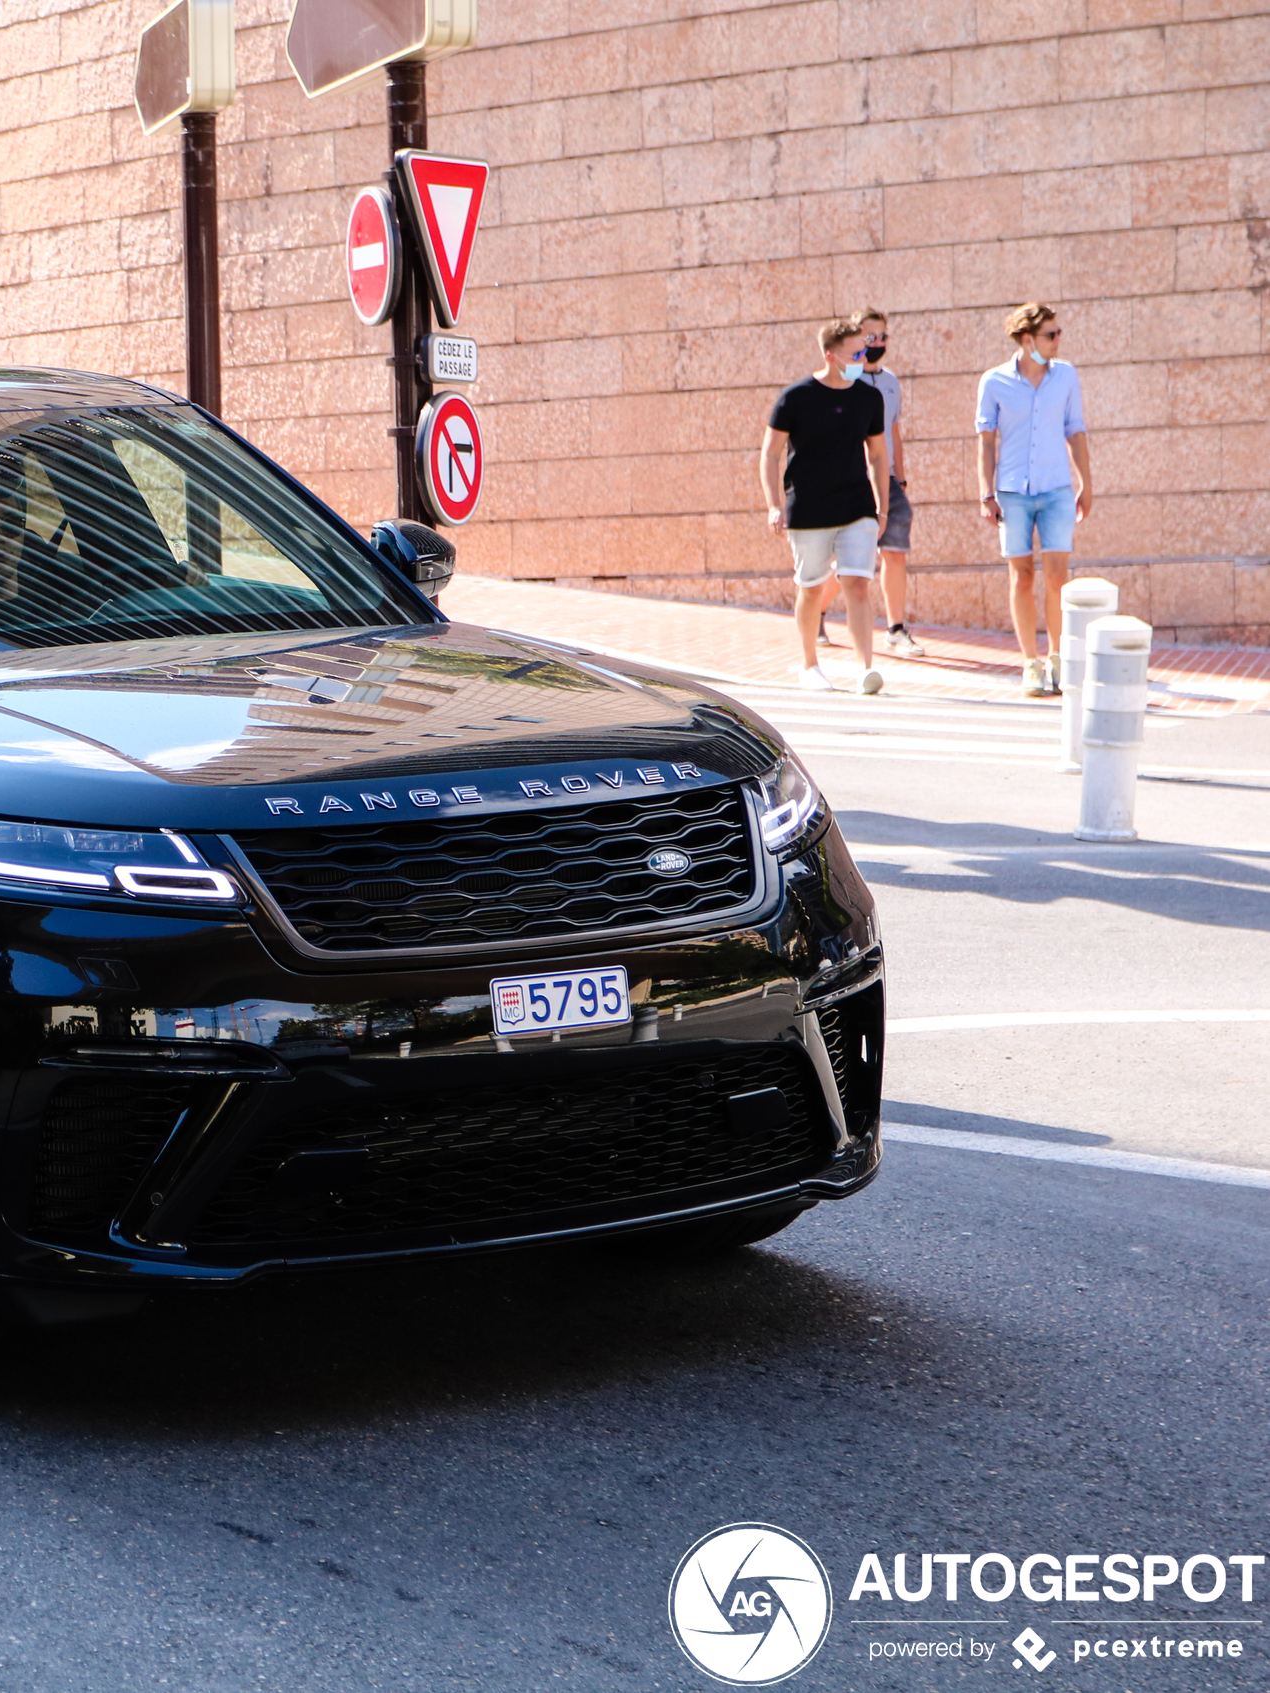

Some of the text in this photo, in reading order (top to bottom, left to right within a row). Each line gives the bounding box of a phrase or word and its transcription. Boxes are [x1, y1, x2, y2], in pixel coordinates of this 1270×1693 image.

[438, 339, 473, 359] CÉDEZ LE
[439, 360, 472, 377] PASSAGE
[264, 762, 702, 815] RANGE ROVER
[655, 853, 676, 864] LAND
[660, 859, 685, 871] ROVER
[529, 975, 622, 1022] 5795
[504, 1007, 520, 1018] MC
